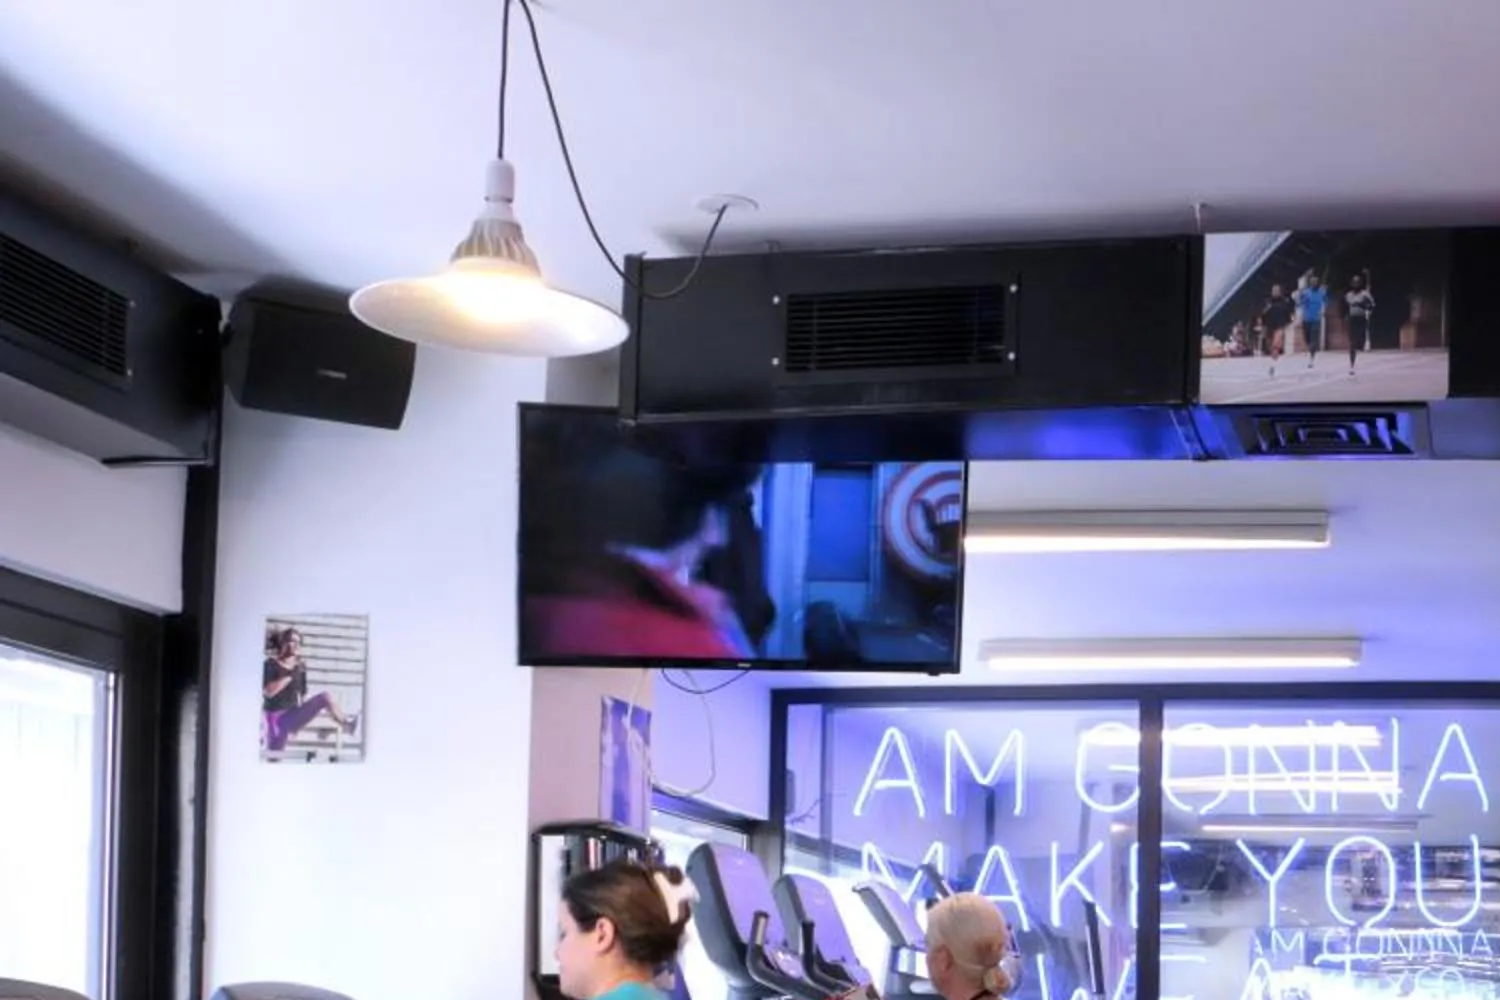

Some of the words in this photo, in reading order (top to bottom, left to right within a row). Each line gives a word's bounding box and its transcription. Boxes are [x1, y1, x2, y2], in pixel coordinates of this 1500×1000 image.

[853, 725, 1024, 818] AM
[1074, 717, 1490, 816] GONNA
[860, 839, 1190, 932] MAKE
[1236, 835, 1484, 930] YOU
